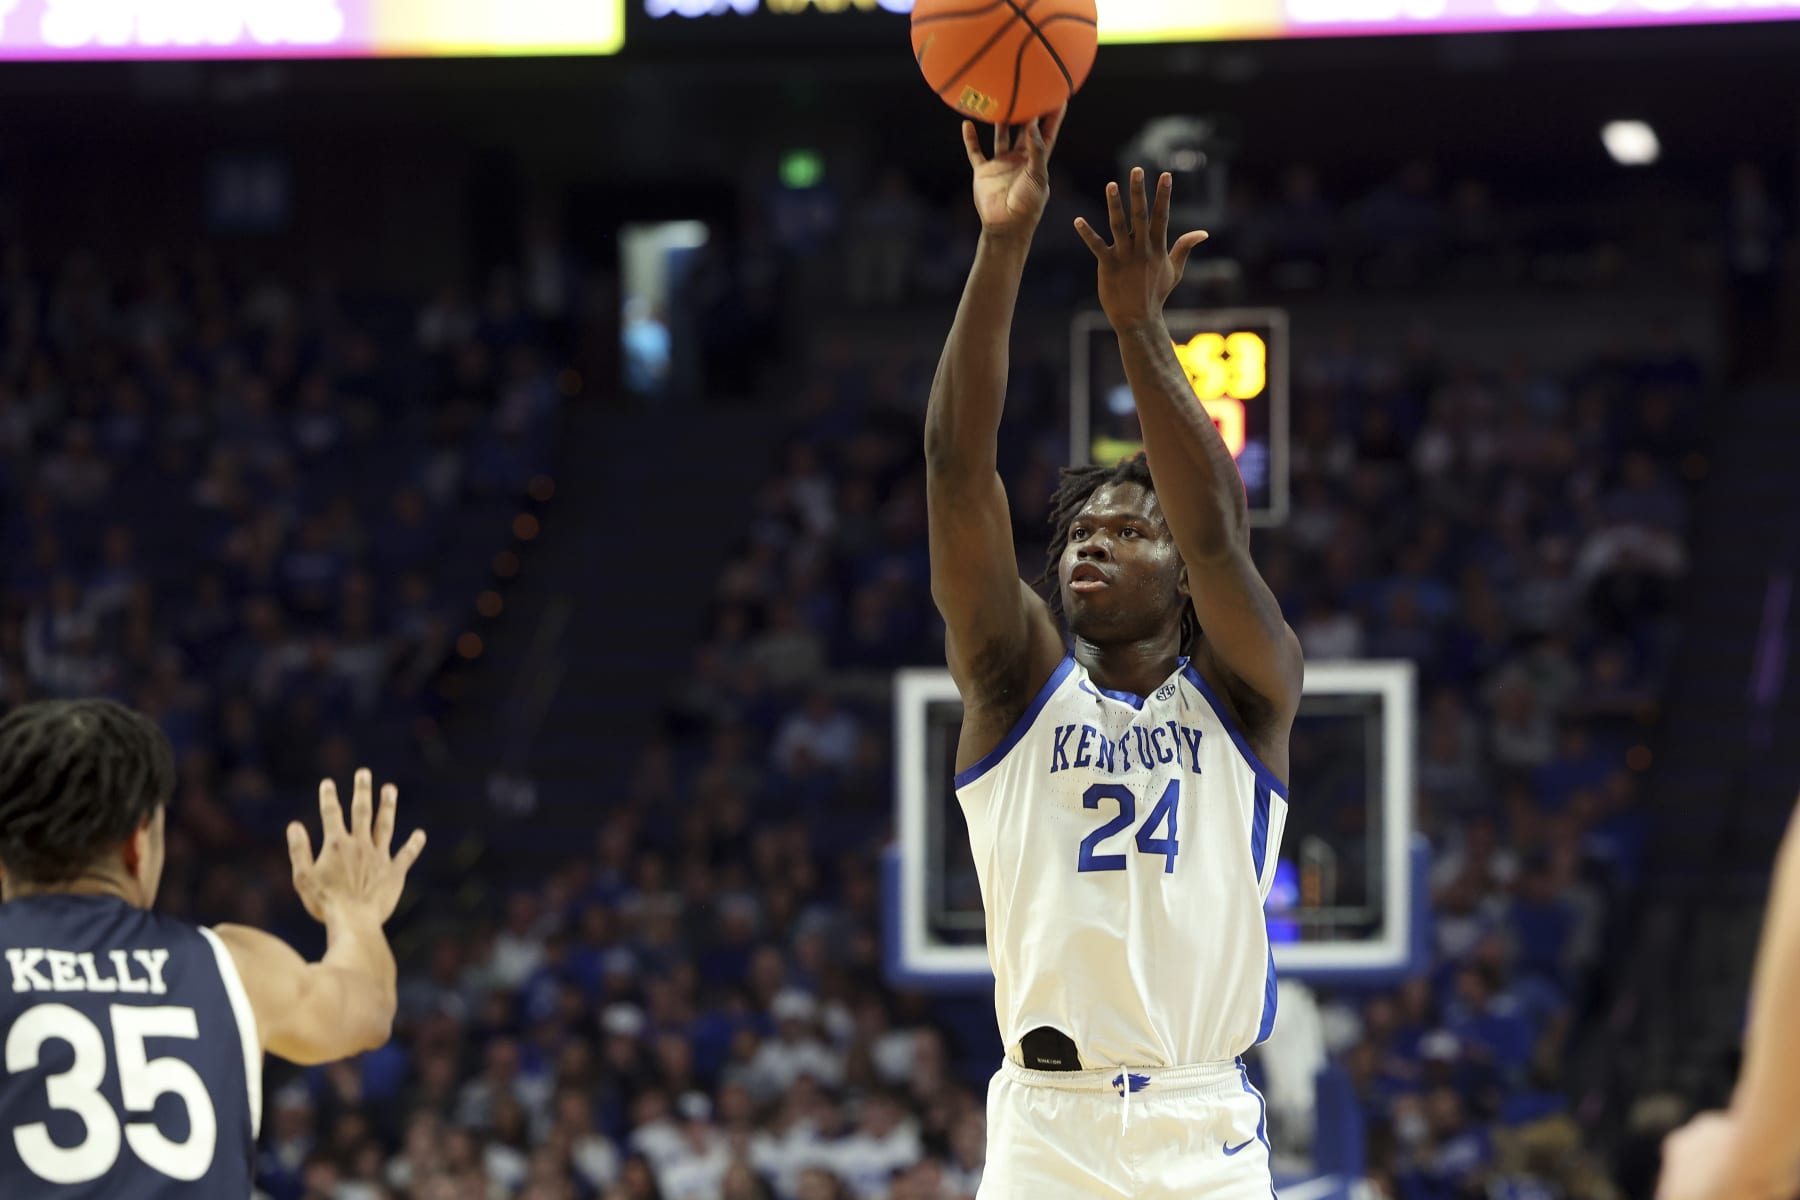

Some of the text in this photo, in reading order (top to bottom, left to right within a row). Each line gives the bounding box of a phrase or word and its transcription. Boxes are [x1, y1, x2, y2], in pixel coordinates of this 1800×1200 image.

[1157, 684, 1175, 700] SEC
[1078, 778, 1181, 873] 24
[5, 948, 169, 994] KELLY
[5, 1003, 217, 1184] 35
